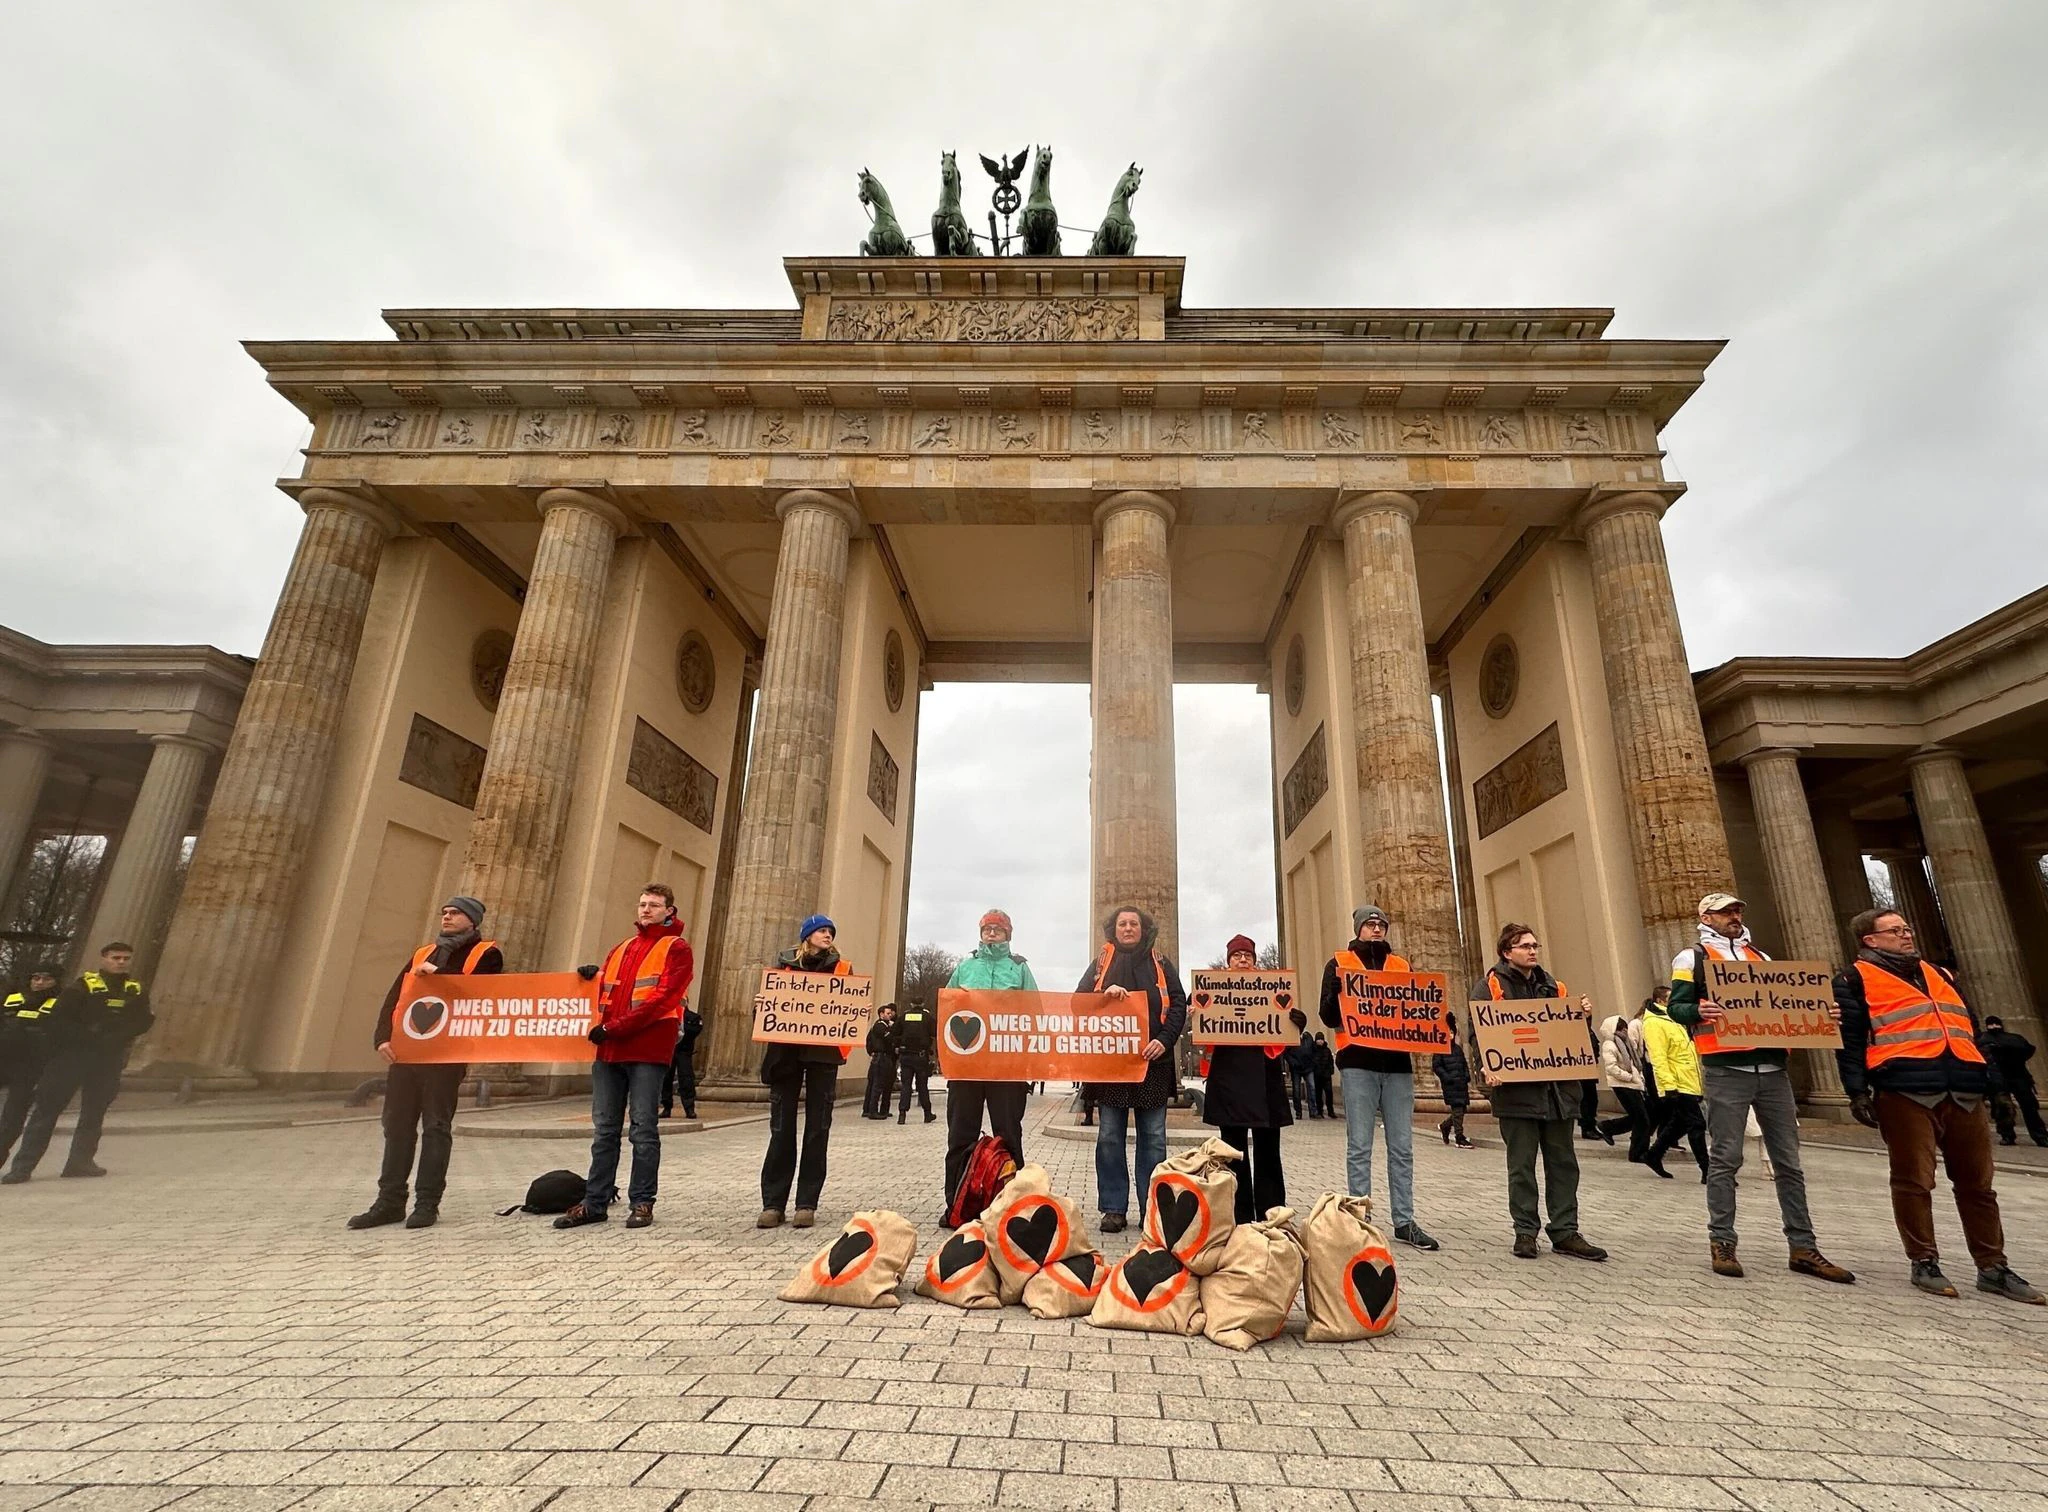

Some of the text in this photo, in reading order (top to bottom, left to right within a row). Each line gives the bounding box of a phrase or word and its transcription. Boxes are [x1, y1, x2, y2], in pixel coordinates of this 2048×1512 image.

[765, 972, 871, 997] Ein toter Planet
[1194, 974, 1292, 994] Klimakatastrophe
[1712, 962, 1829, 986] Hochwasser
[1213, 991, 1269, 1007] zulassen
[1345, 973, 1443, 1003] Klimaschutz
[452, 998, 592, 1016] WEG VON FOSSIL
[759, 996, 779, 1012] ist
[780, 997, 815, 1014] eine
[1358, 998, 1441, 1021] ist der beste
[1711, 990, 1830, 1011] kennt keinen
[762, 1013, 858, 1039] Bannmeile
[989, 1014, 1141, 1034] WEG VON FOSSIL
[1200, 1013, 1282, 1035] kriminell
[1476, 1003, 1584, 1027] Klimaschutz
[1715, 1013, 1838, 1038] Denkmalschutz
[448, 1018, 592, 1037] HIN ZU GERECHT
[1346, 1015, 1448, 1045] Denkmalschutz
[989, 1034, 1141, 1055] HIN ZU GERECHT
